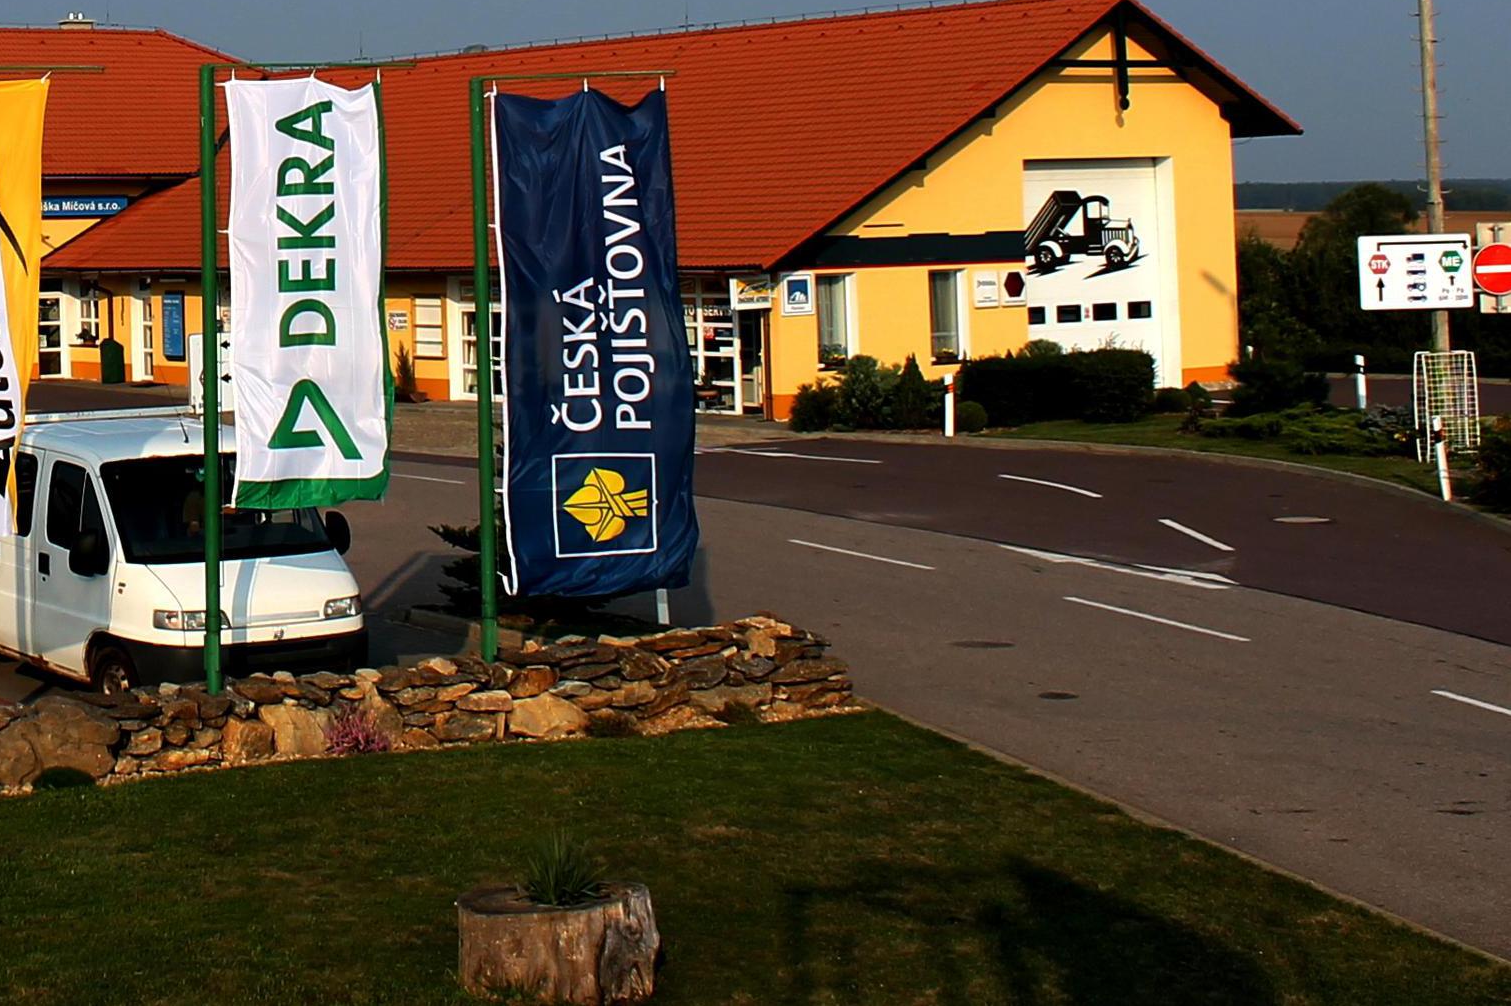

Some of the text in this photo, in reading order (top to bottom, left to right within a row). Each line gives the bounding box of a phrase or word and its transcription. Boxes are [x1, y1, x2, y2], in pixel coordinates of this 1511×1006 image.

[97, 202, 121, 211] s.r.o.
[274, 100, 337, 349] DEKRA
[598, 144, 653, 431] POJIŠŤOVNA
[1370, 260, 1389, 270] STK
[1442, 256, 1461, 268] ME
[551, 276, 602, 433] ČESKÁ
